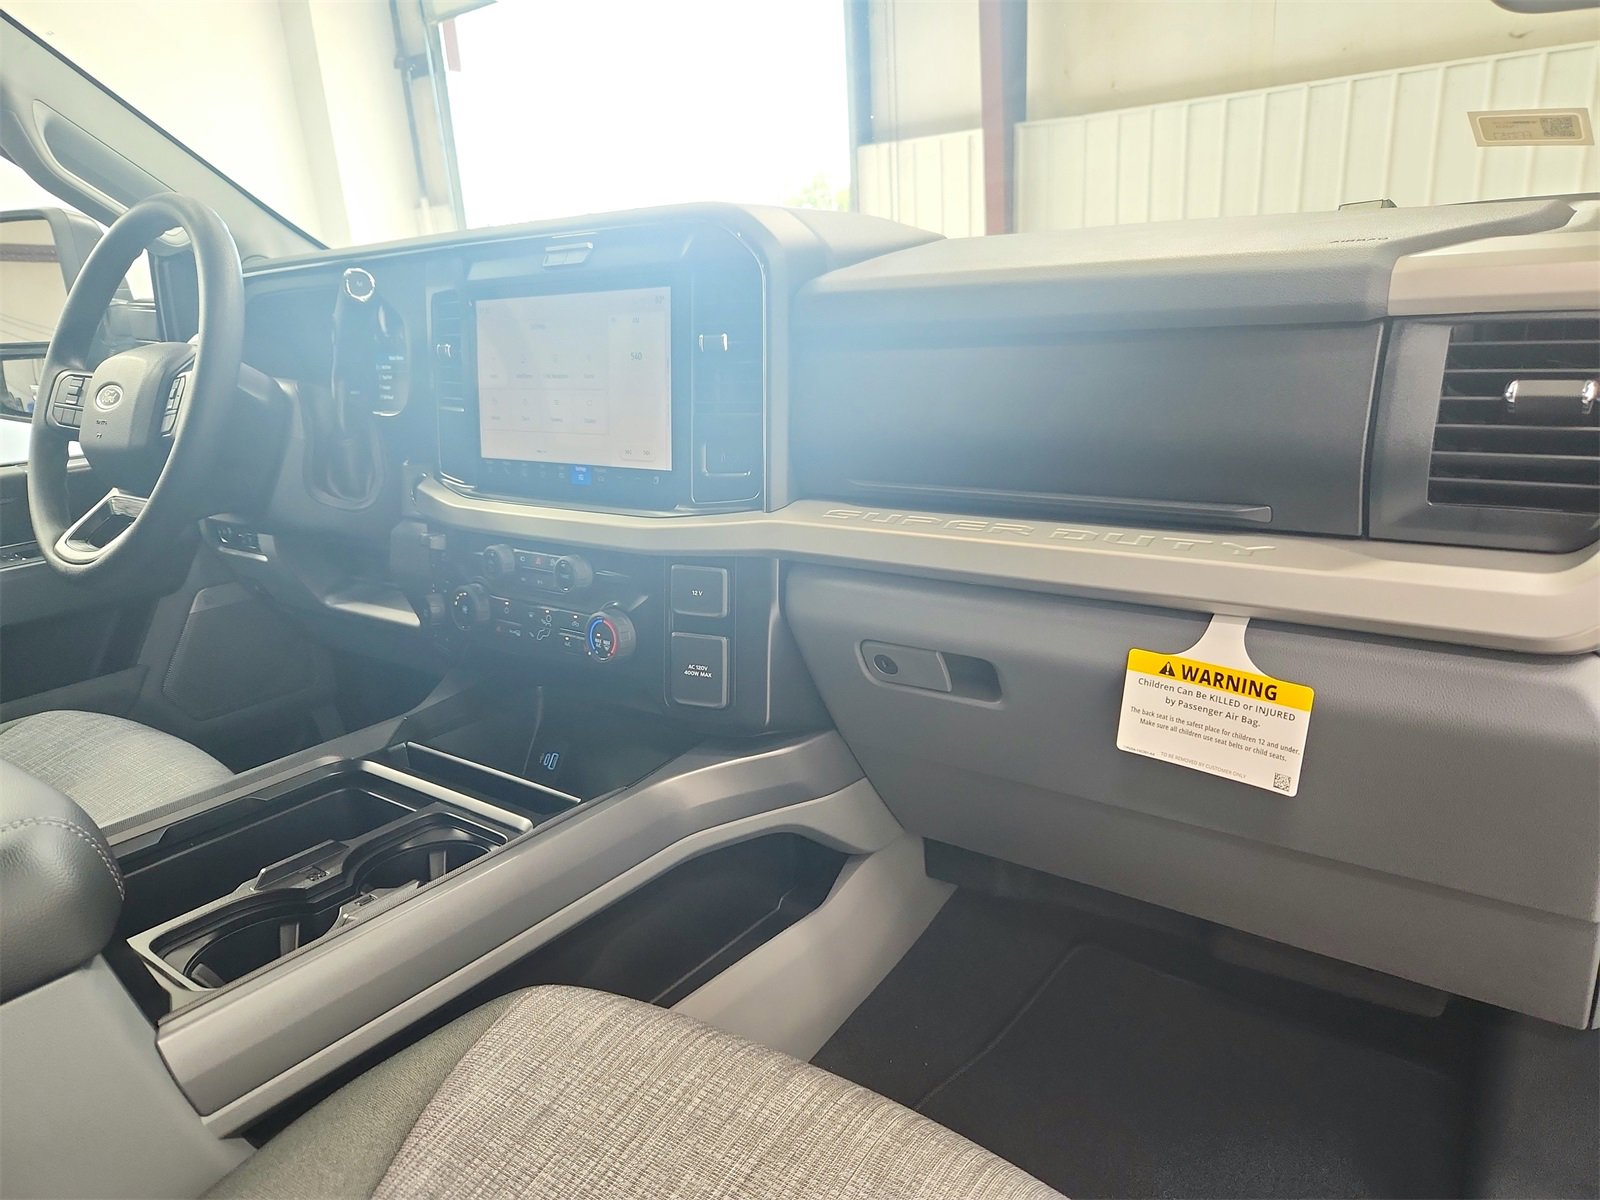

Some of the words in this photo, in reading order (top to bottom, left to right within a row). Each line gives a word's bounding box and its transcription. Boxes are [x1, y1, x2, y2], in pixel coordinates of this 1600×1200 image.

[823, 509, 1035, 536] SUPER
[1049, 527, 1277, 557] DUTY
[1138, 677, 1175, 692] Children
[1177, 686, 1194, 697] Can
[1195, 690, 1207, 700] Be
[1209, 693, 1241, 708] KILLED
[1242, 703, 1253, 711] or
[1255, 705, 1296, 721] INJURED
[1181, 664, 1278, 701] WARNING
[1130, 705, 1140, 714] The
[1141, 708, 1155, 717] back
[1156, 712, 1168, 720] seat
[1169, 714, 1174, 722] is
[1175, 717, 1185, 725] the
[1186, 720, 1204, 730] safest
[1204, 724, 1220, 734] place
[1221, 728, 1231, 736] for
[1231, 731, 1256, 744] children
[1266, 741, 1279, 749] and
[1280, 744, 1300, 755] under.
[1165, 696, 1176, 707] by
[1178, 699, 1223, 717] Passenger
[1225, 711, 1239, 721] Air
[1241, 715, 1260, 728] Bag.
[1139, 718, 1156, 728] Make
[1156, 722, 1169, 730] sure
[1178, 728, 1202, 739] children
[1203, 734, 1213, 742] use
[1214, 737, 1227, 746] seat
[1229, 740, 1243, 750] belts
[1252, 747, 1268, 757] child
[1269, 751, 1287, 762] seats.
[1175, 754, 1197, 766] REMOVED
[1205, 763, 1232, 775] CUSTOMER
[1232, 770, 1247, 780] ONLY
